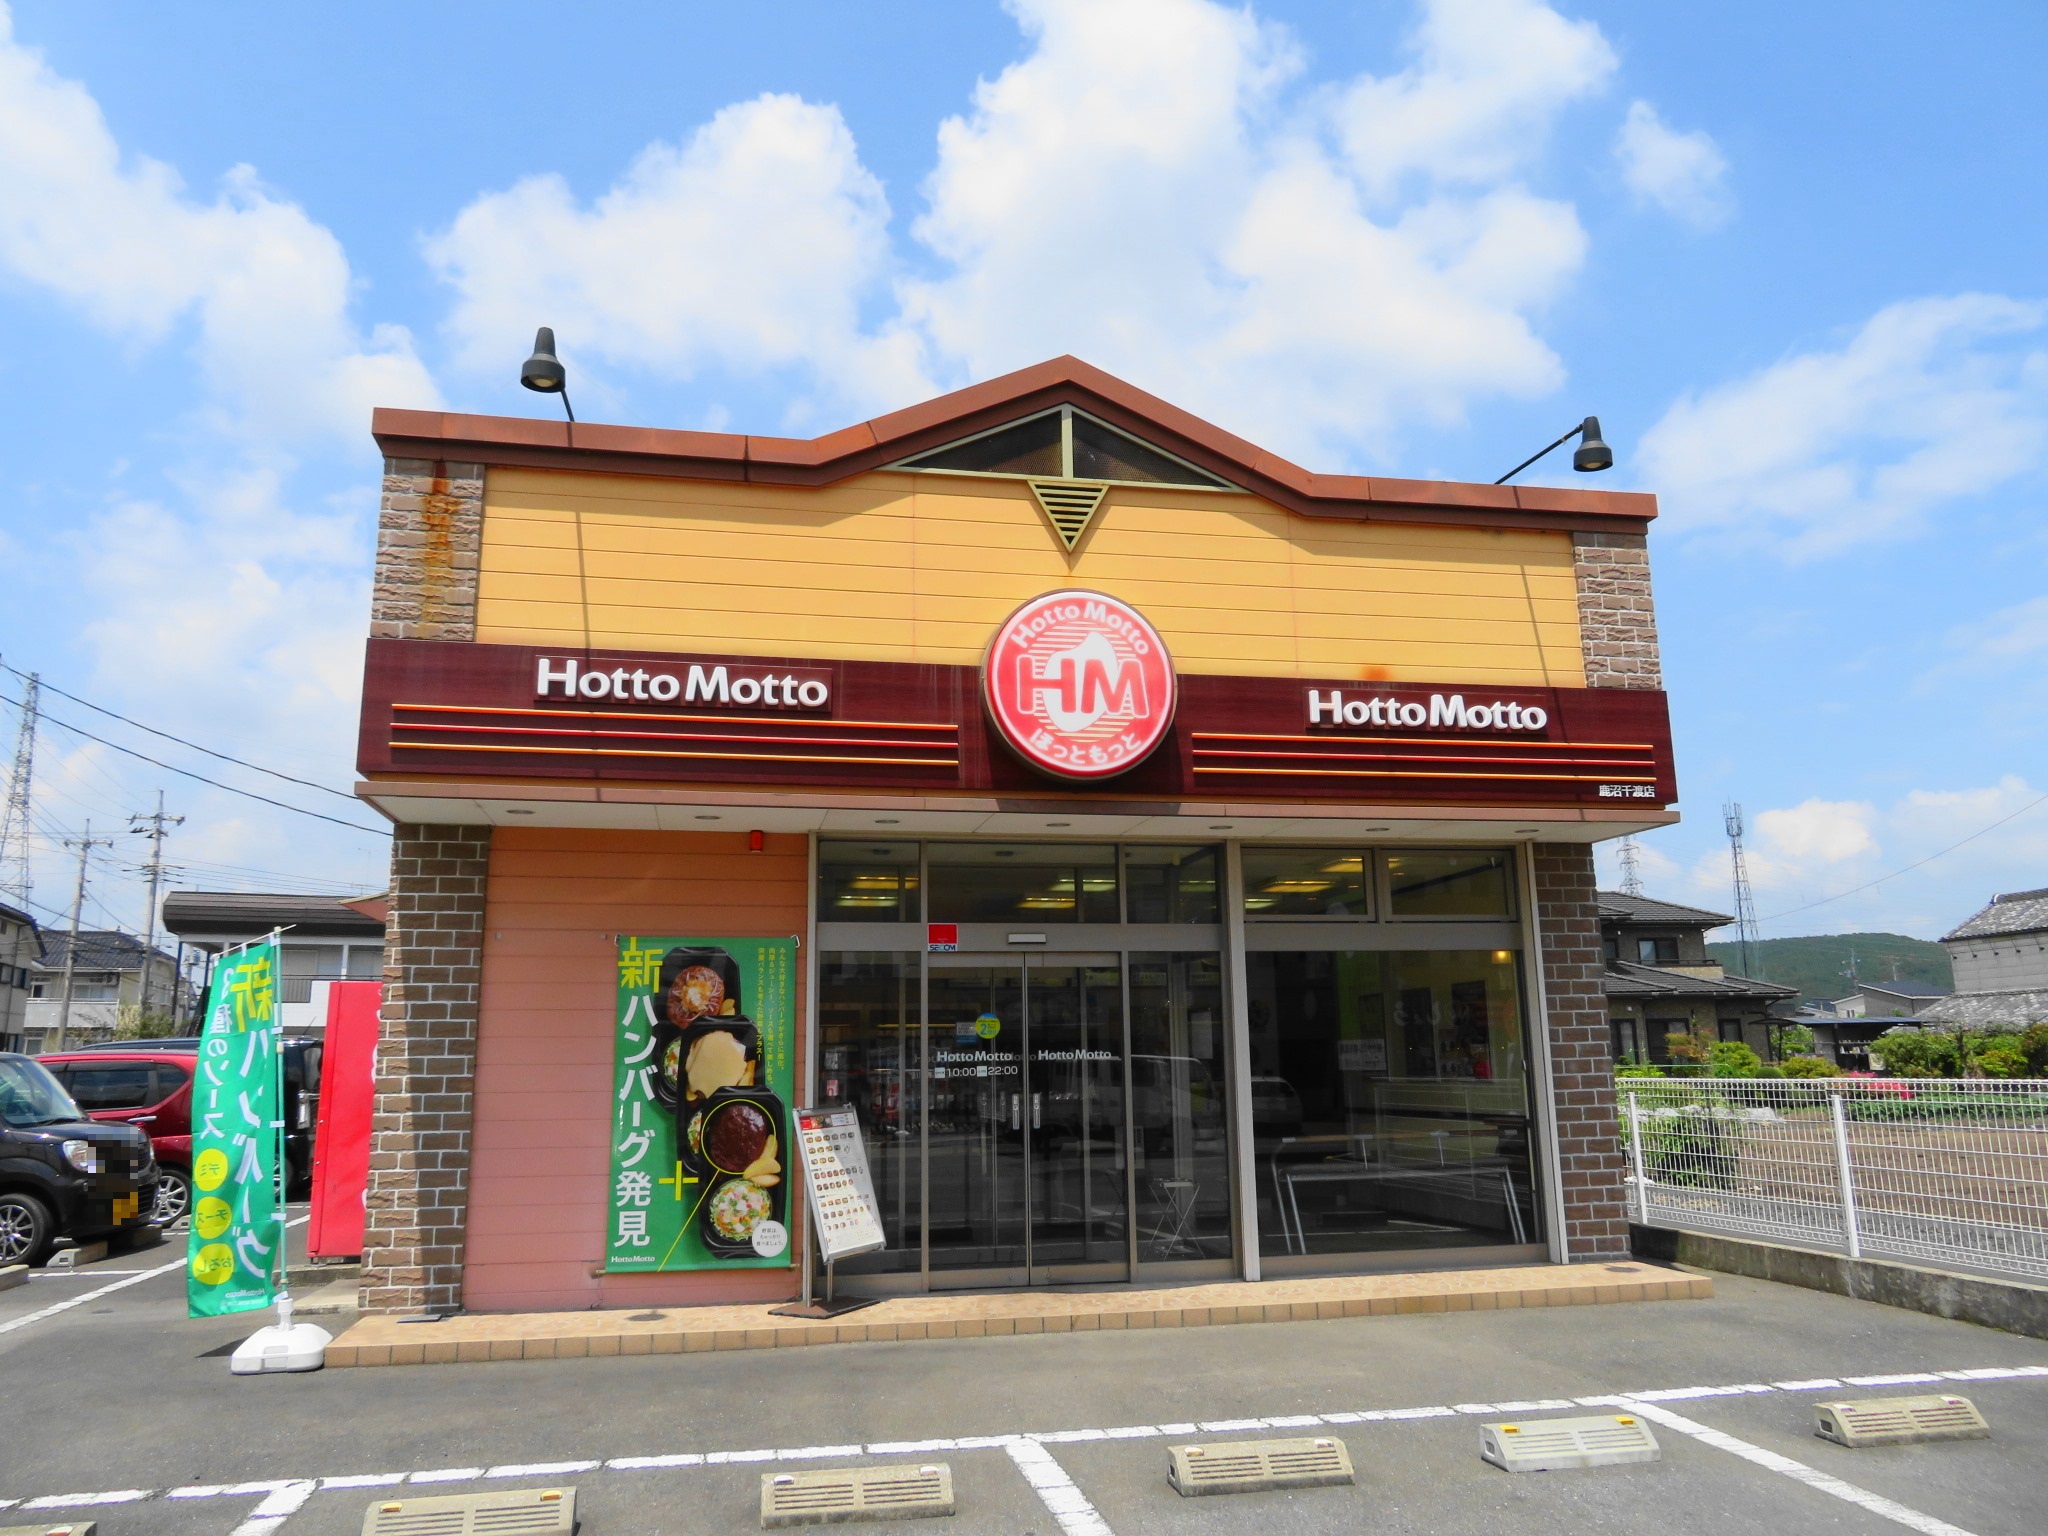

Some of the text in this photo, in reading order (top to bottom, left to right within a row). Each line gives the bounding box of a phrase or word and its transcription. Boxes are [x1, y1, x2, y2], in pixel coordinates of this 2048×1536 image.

[1016, 653, 1150, 719] HM
[1029, 728, 1142, 765] ほっともっと
[1599, 785, 1656, 798] 鹿沼千渡店
[947, 1067, 976, 1078] 10:00
[987, 1066, 1018, 1076] 22:00
